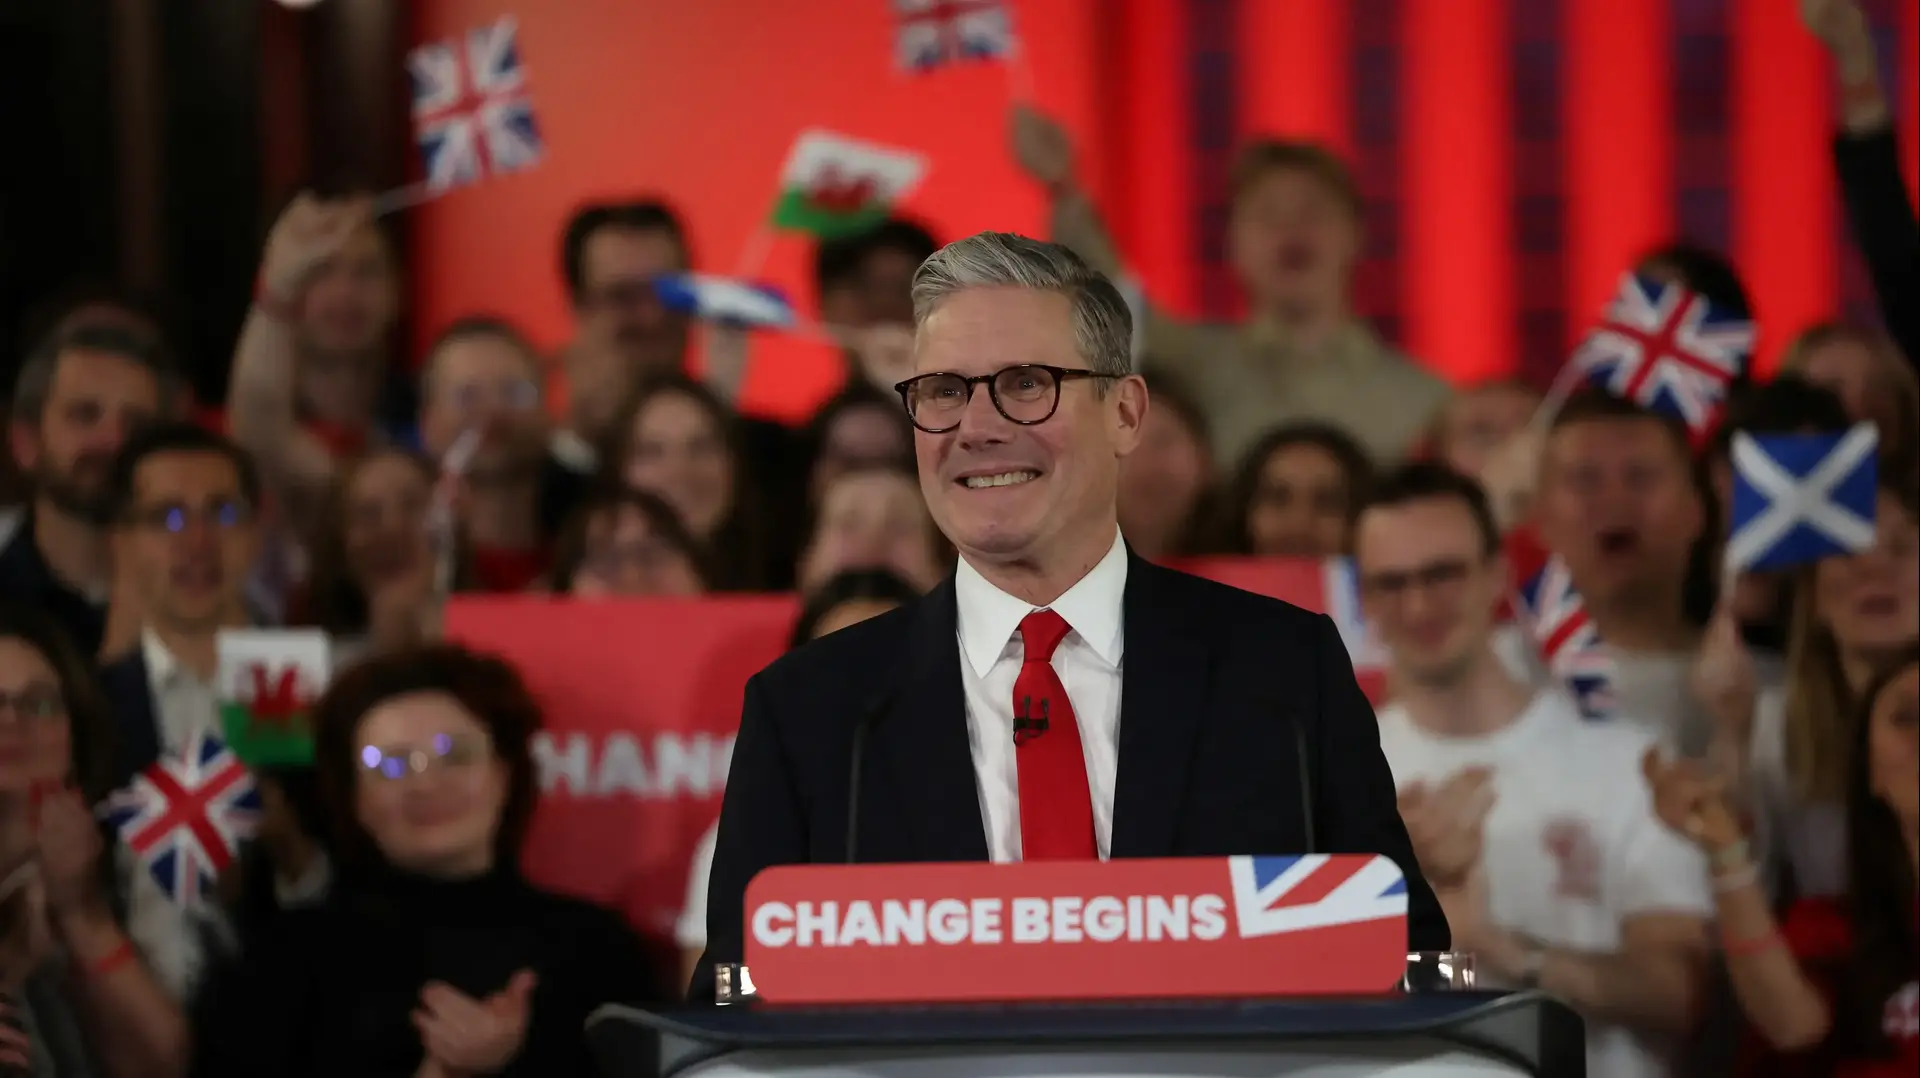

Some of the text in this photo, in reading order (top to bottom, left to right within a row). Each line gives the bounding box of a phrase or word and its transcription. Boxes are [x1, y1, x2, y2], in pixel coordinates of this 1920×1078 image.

[530, 731, 737, 797] HAN
[752, 894, 1227, 947] CHANGE BEGINS
